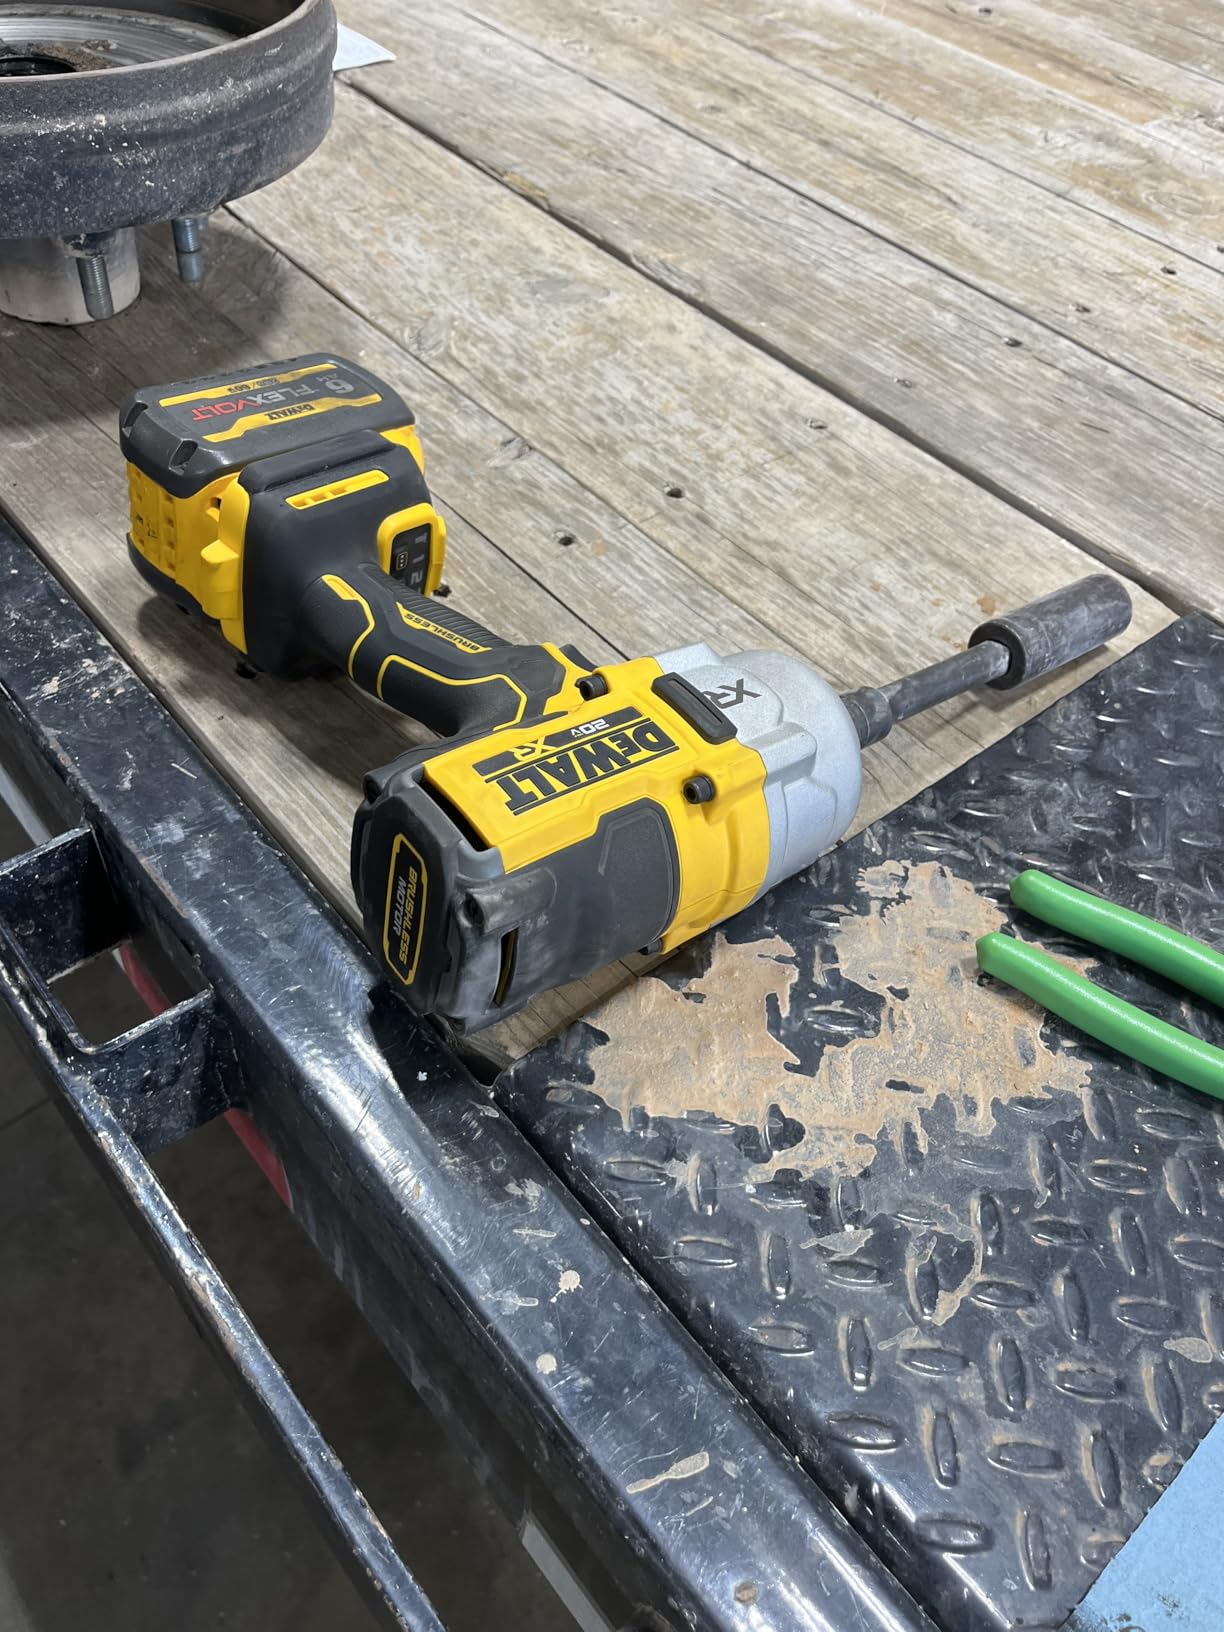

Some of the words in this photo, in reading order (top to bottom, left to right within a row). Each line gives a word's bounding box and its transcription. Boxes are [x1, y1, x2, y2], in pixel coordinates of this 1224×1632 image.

[191, 383, 320, 421] FLEXVOLT
[324, 378, 355, 394] 6
[404, 613, 481, 651] BRUSHLESS
[508, 735, 559, 762] XR
[392, 875, 407, 937] MOTOR
[399, 865, 418, 966] BRUSHLESS
